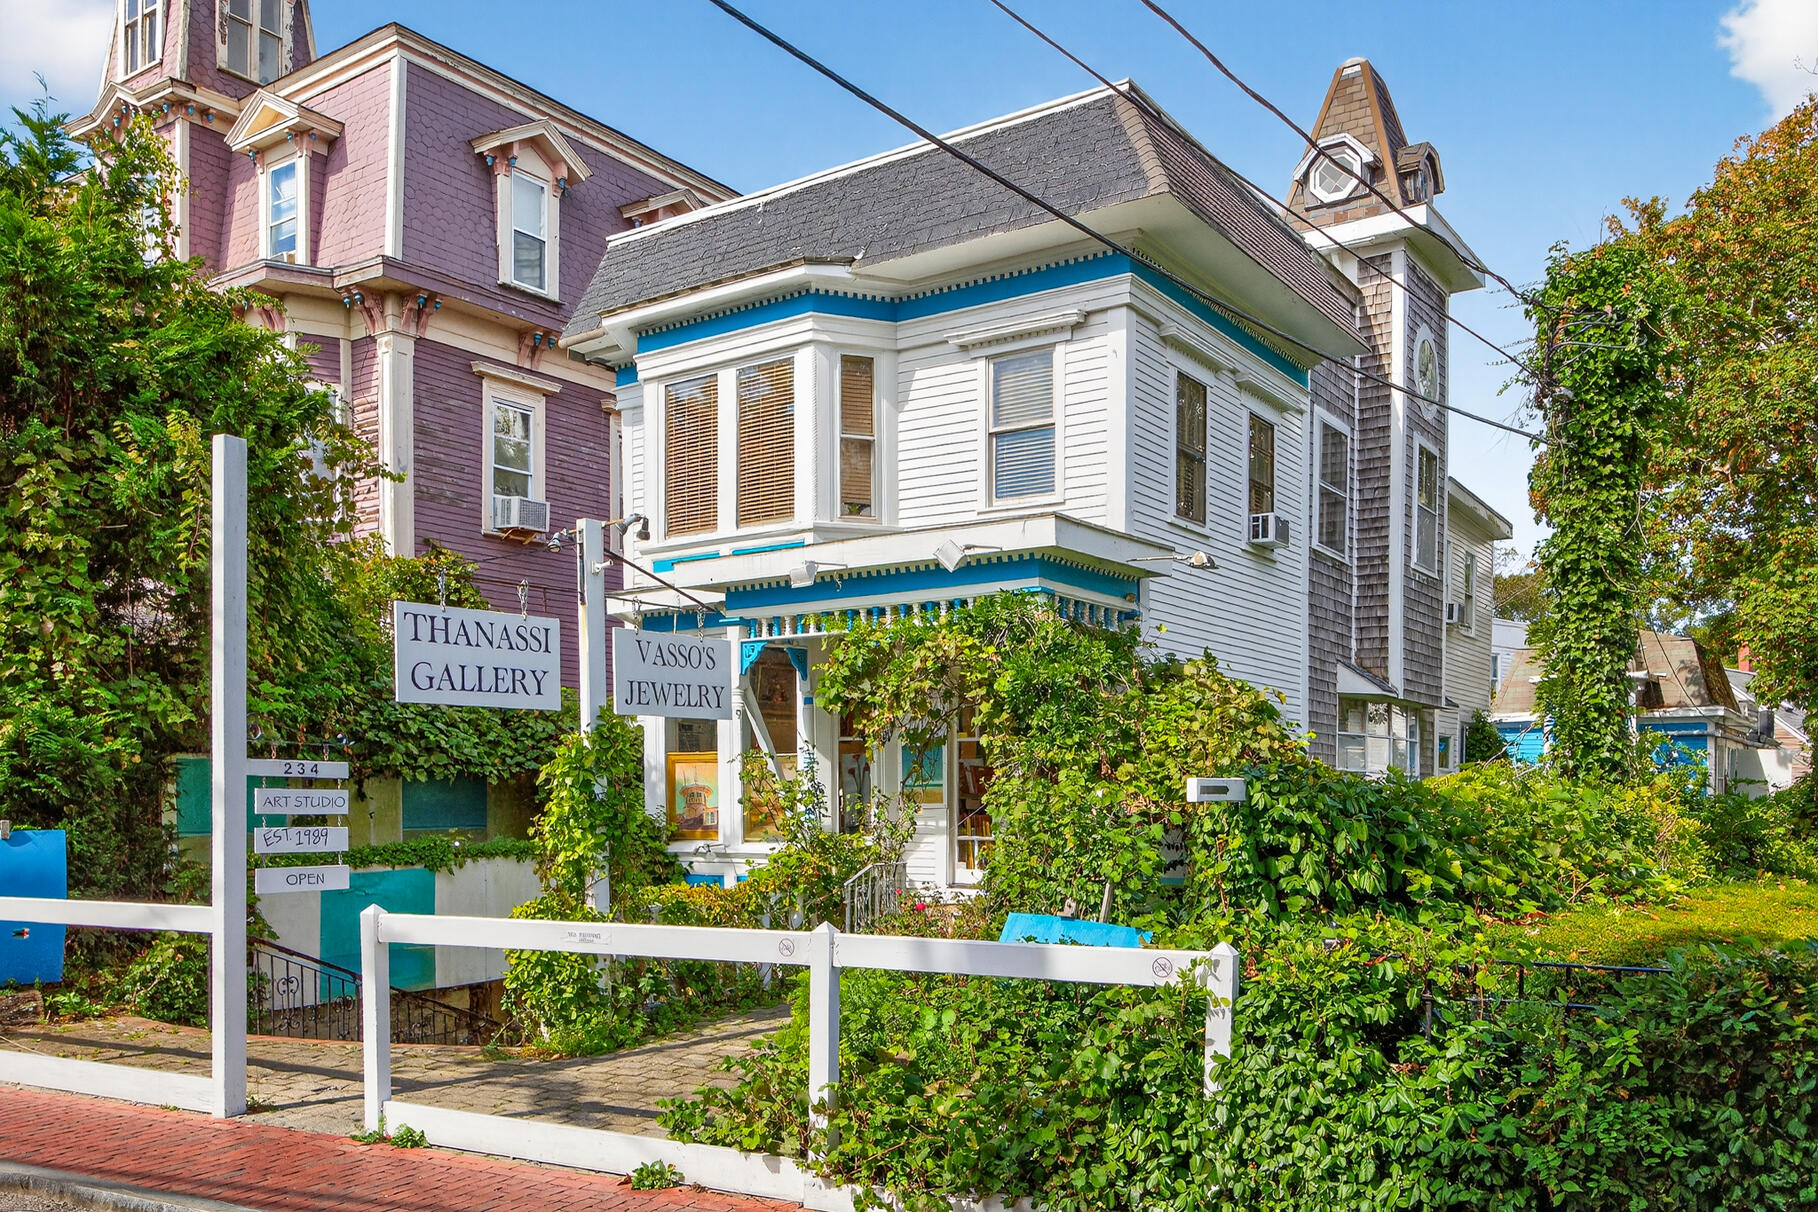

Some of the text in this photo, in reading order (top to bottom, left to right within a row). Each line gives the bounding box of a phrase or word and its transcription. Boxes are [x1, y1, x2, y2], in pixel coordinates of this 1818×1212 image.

[403, 612, 552, 653] THANASSI
[635, 639, 716, 671] VASSO'S
[410, 661, 549, 696] GALLERY
[625, 679, 725, 709] JEWELRY
[283, 762, 319, 775] 234
[262, 796, 346, 808] ART STUDIO
[263, 828, 329, 847] EST. 1989
[286, 873, 325, 886] OPEN
